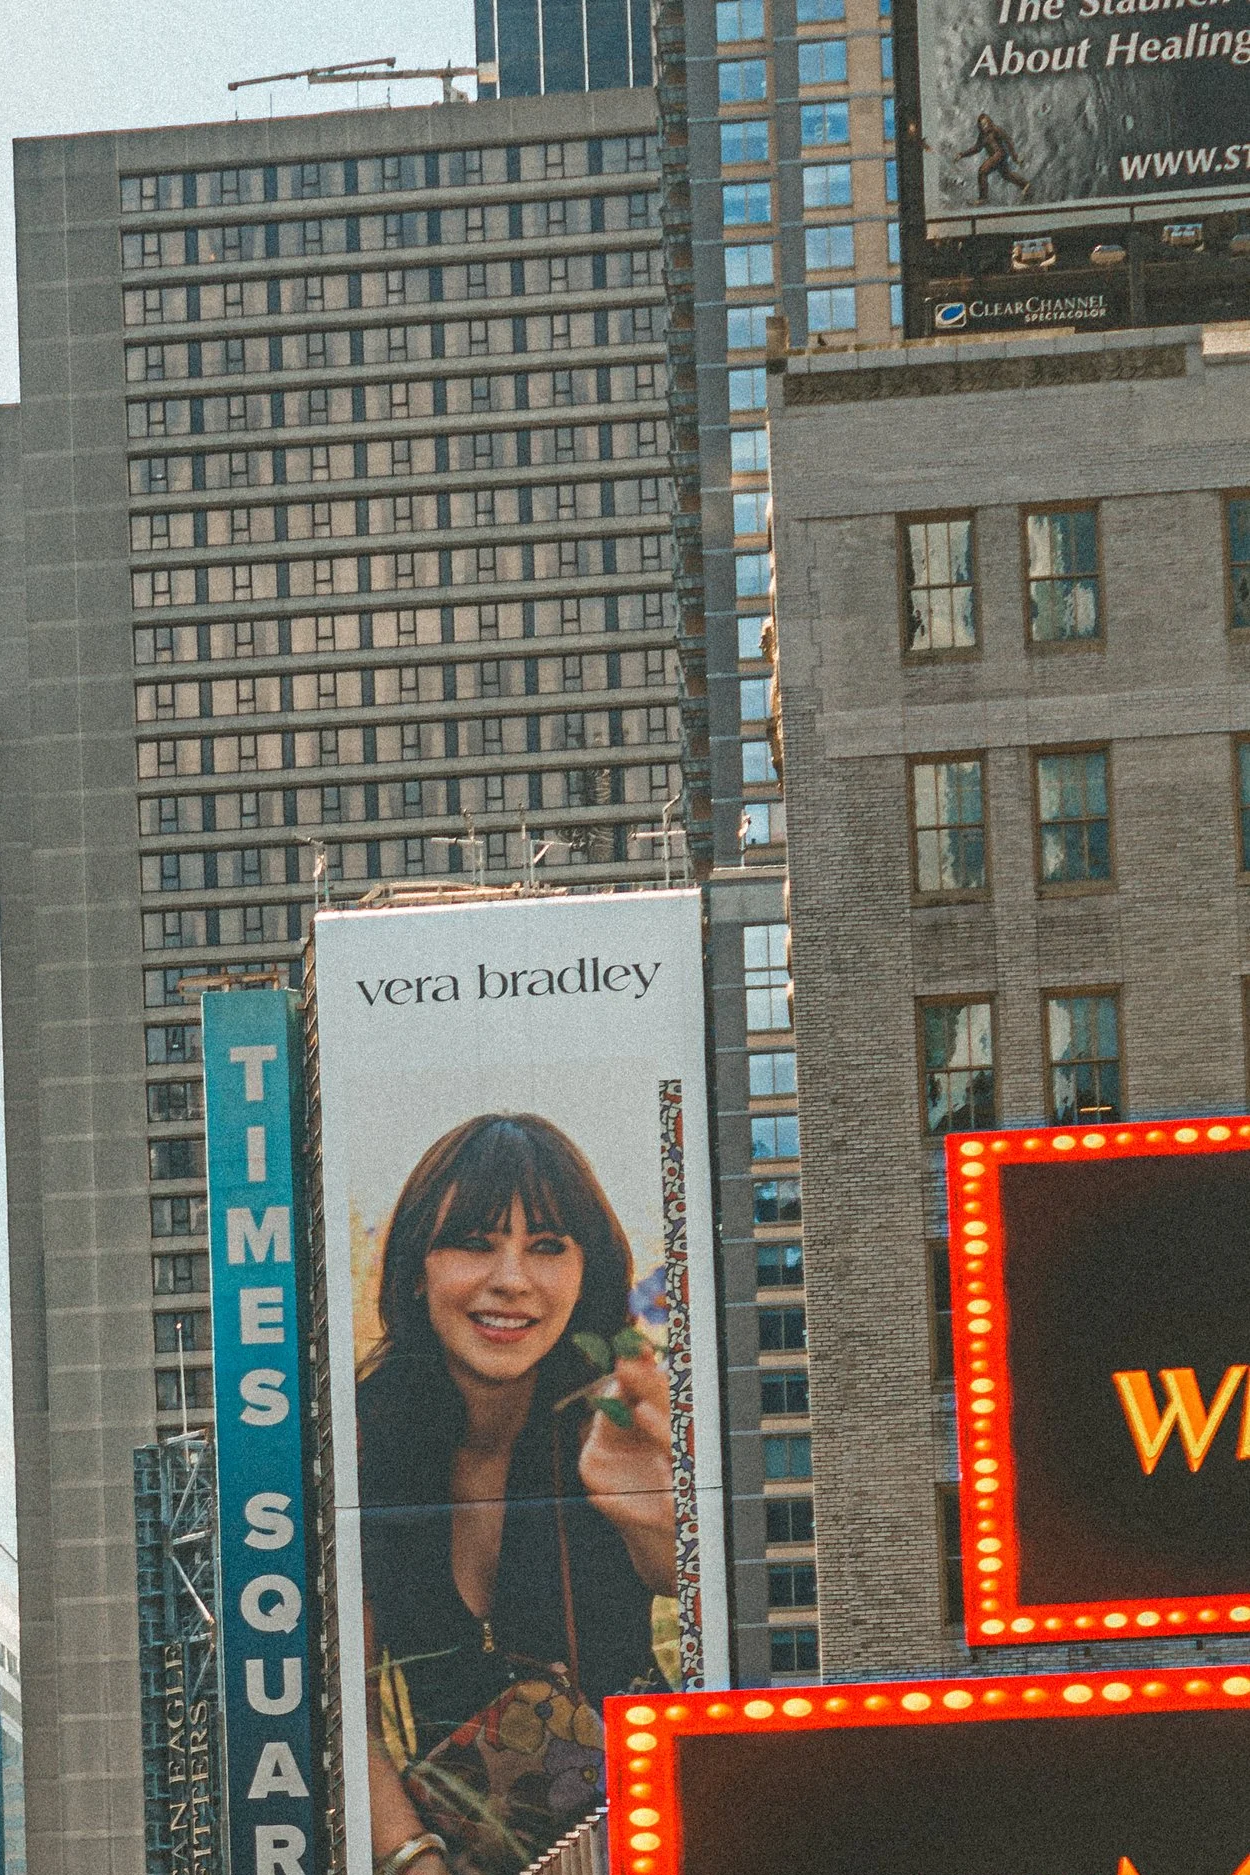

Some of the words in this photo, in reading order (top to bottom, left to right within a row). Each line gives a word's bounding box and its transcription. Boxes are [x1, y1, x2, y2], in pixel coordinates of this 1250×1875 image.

[970, 39, 1091, 78] About
[1105, 22, 1250, 67] Healing
[356, 972, 460, 1007] vera
[477, 957, 662, 1000] bradley
[225, 1044, 292, 1427] TIMES
[165, 1638, 188, 1784] EAGLE
